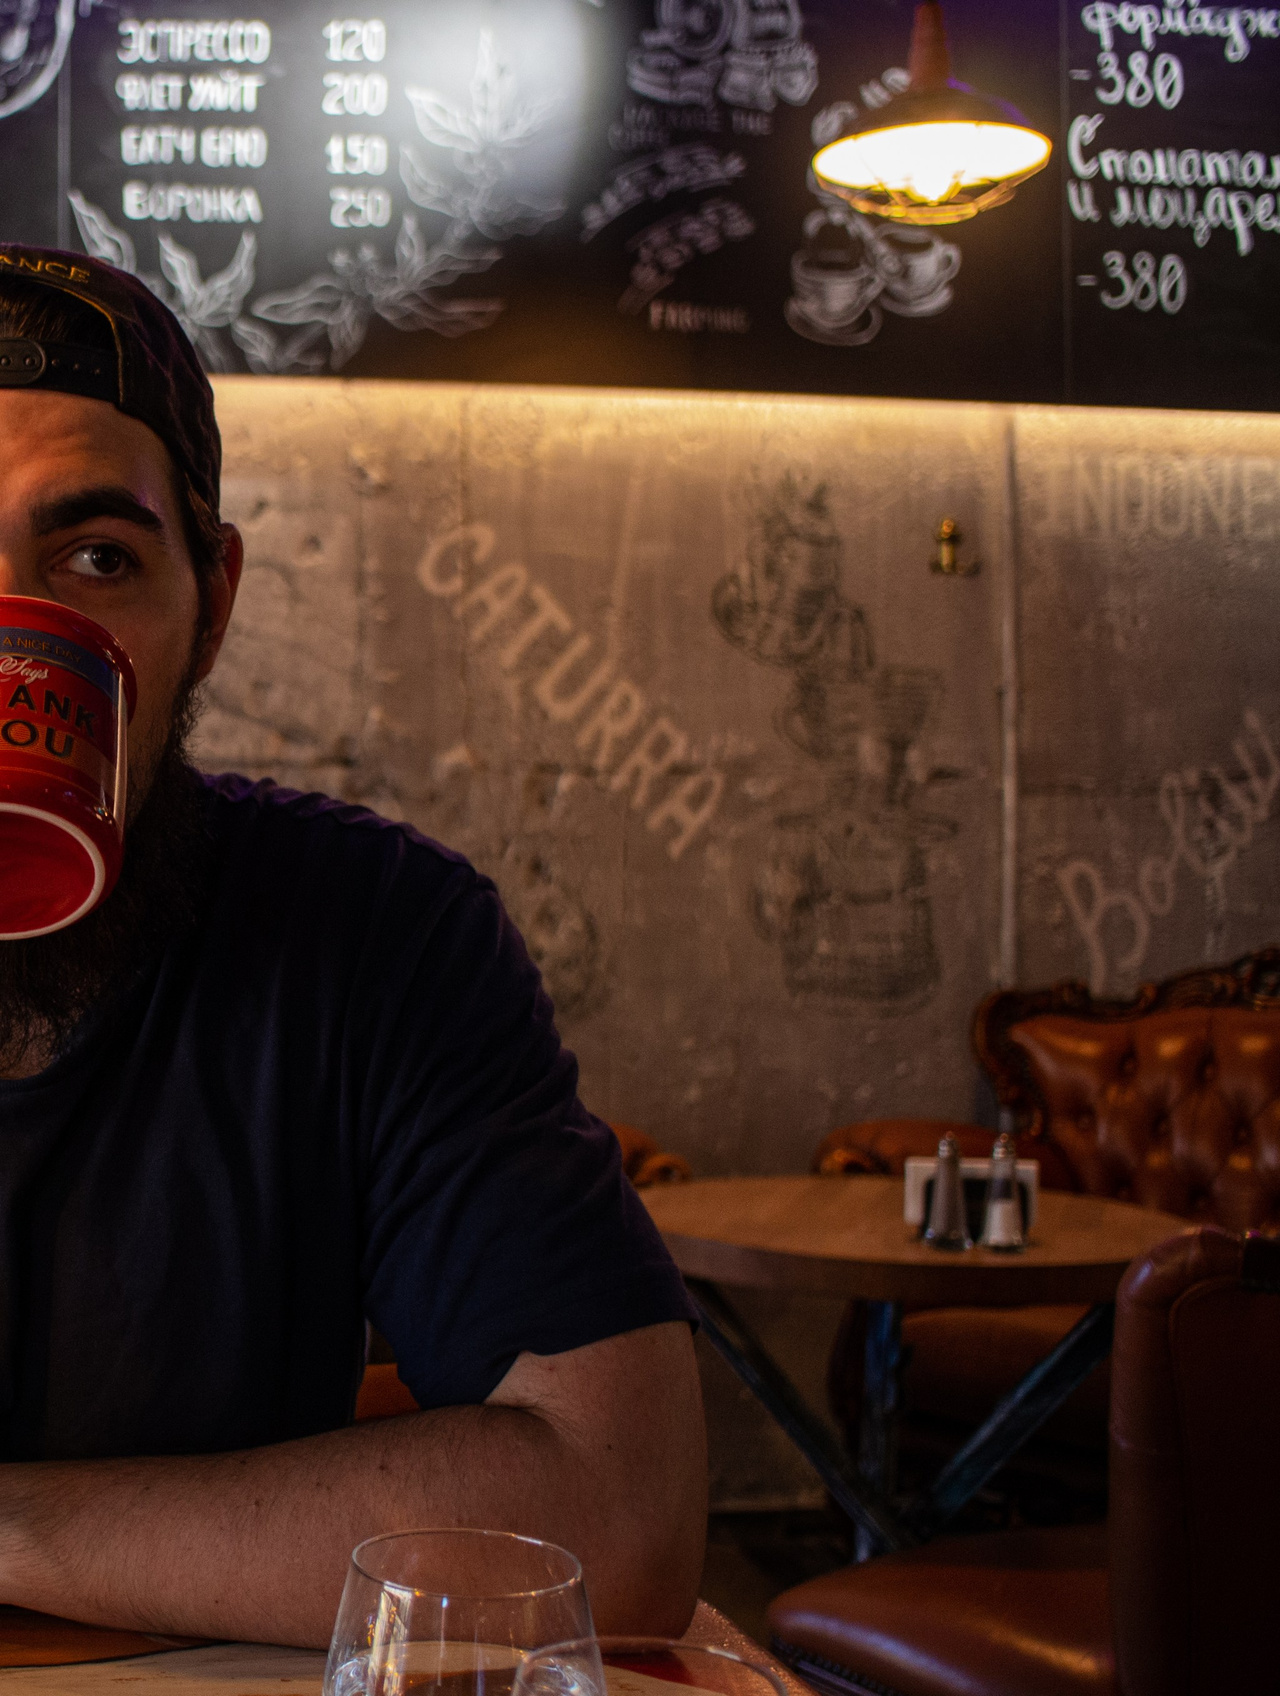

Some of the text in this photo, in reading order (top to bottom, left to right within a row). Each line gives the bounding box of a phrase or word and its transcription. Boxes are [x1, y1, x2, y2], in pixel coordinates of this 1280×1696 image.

[117, 19, 386, 63] ЭСПРЕССО 120
[322, 72, 388, 116] 200
[325, 134, 388, 175] 150
[122, 180, 391, 228] ВОРОНКА 250
[2, 636, 13, 647] A
[17, 638, 51, 652] NICE
[55, 645, 80, 662] DAY
[418, 522, 722, 861] CATURRA
